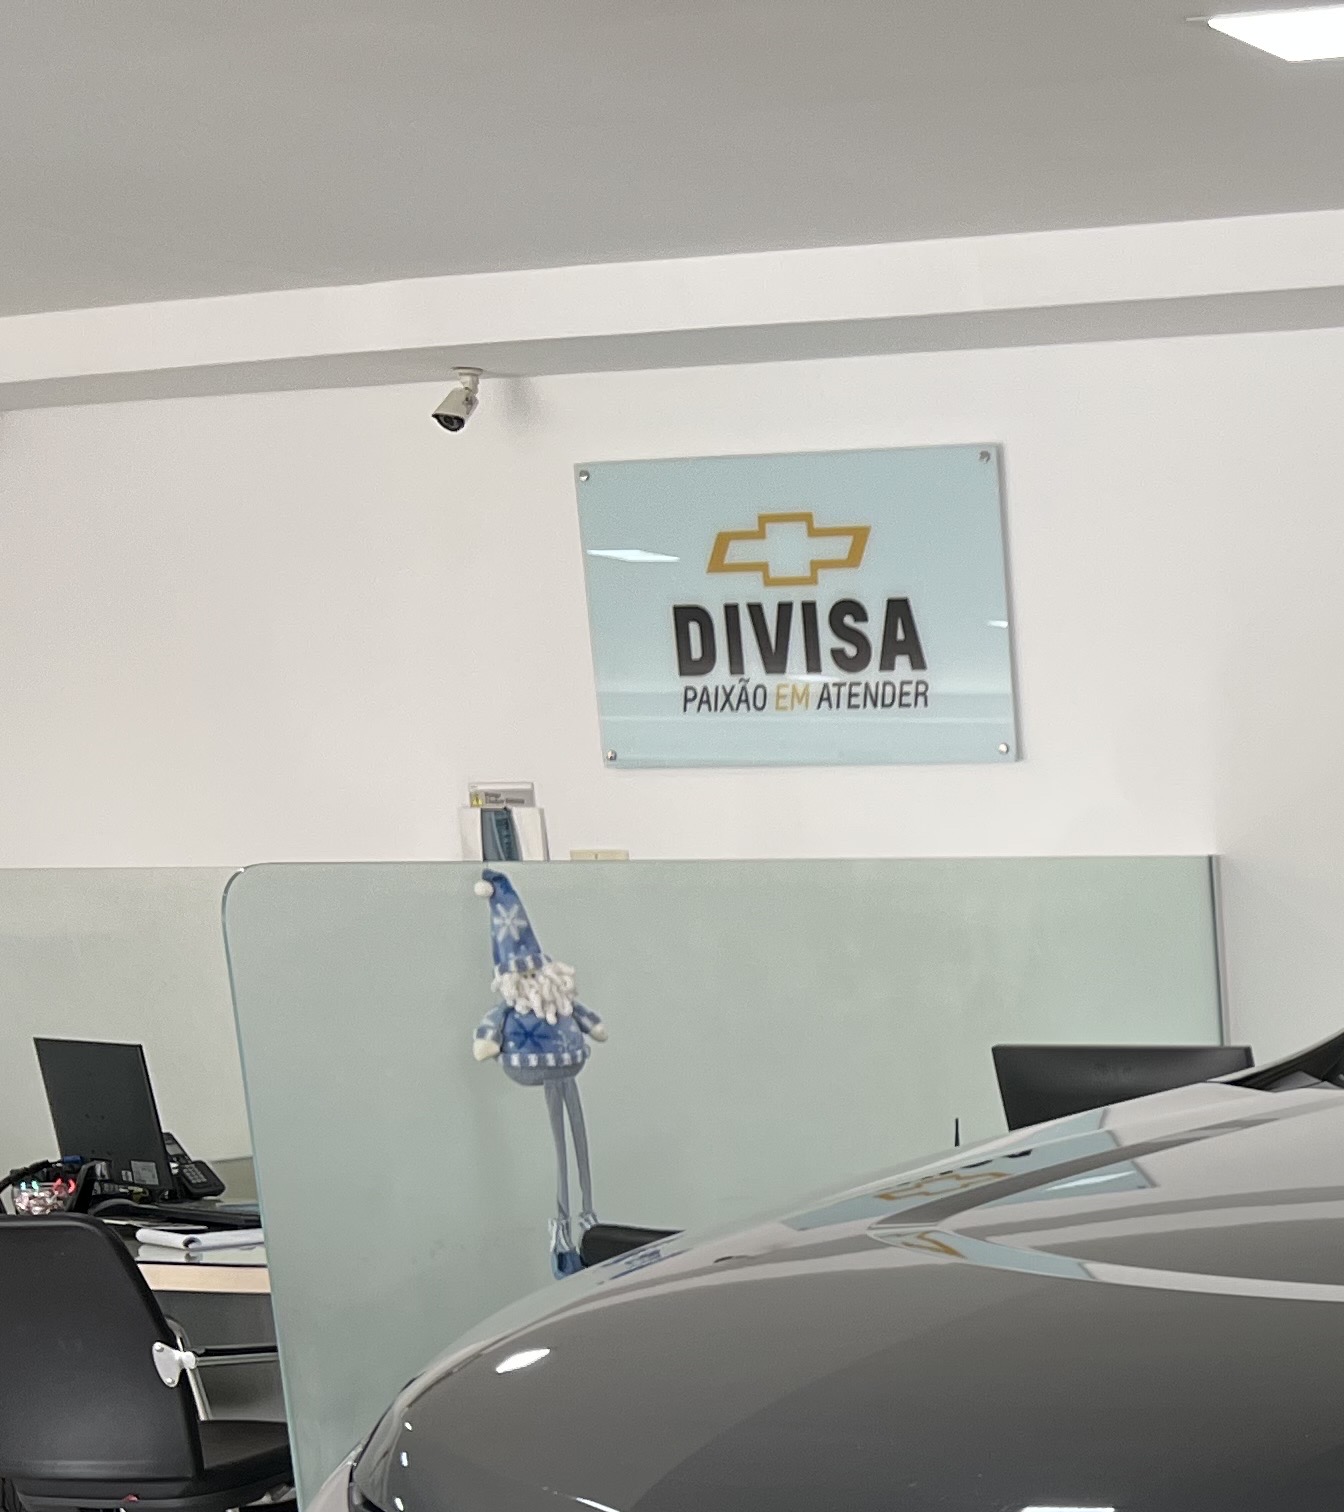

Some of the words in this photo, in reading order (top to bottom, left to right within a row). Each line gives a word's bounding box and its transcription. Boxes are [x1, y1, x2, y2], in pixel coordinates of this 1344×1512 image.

[672, 597, 928, 677] DIVISA
[683, 677, 767, 712] PAIXÃO
[775, 684, 811, 711] EM
[816, 679, 930, 710] ATENDER
